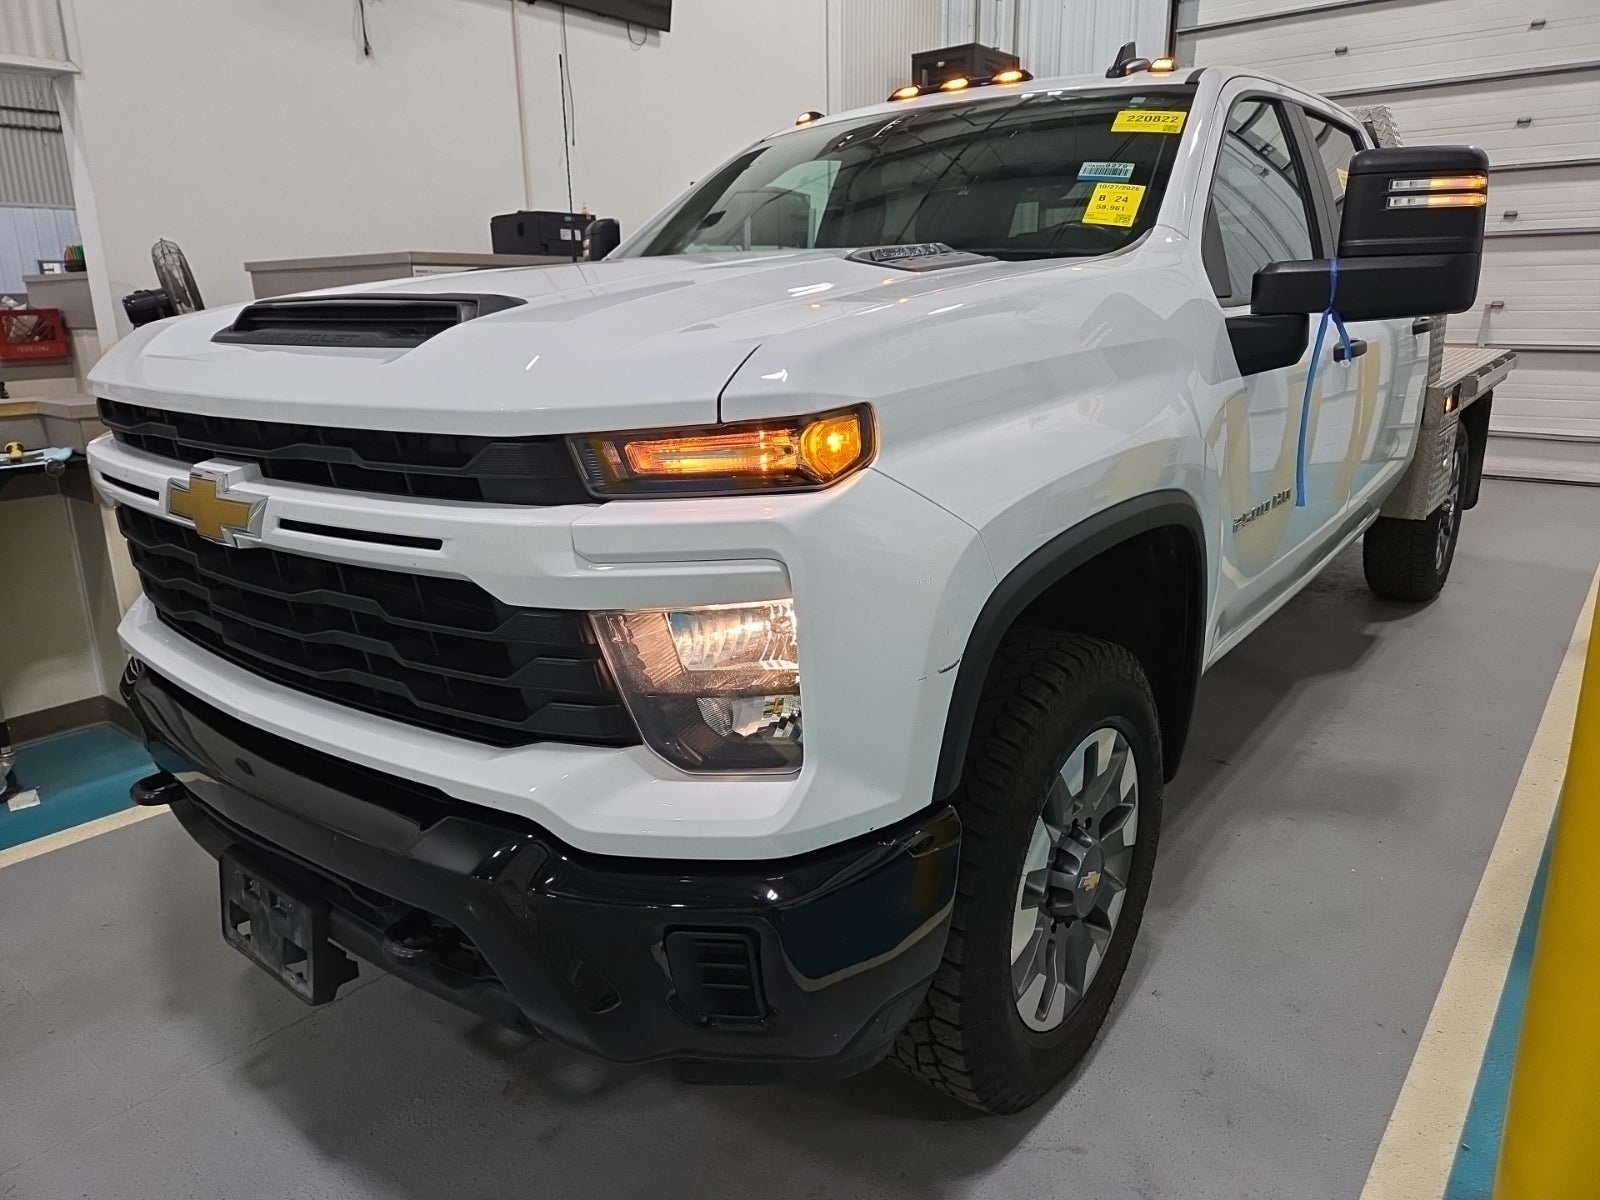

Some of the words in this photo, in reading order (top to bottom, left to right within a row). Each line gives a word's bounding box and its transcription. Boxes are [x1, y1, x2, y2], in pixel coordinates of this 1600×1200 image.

[1126, 115, 1179, 123] 220822
[1114, 195, 1128, 203] 24
[256, 333, 360, 343] CHEVROLET
